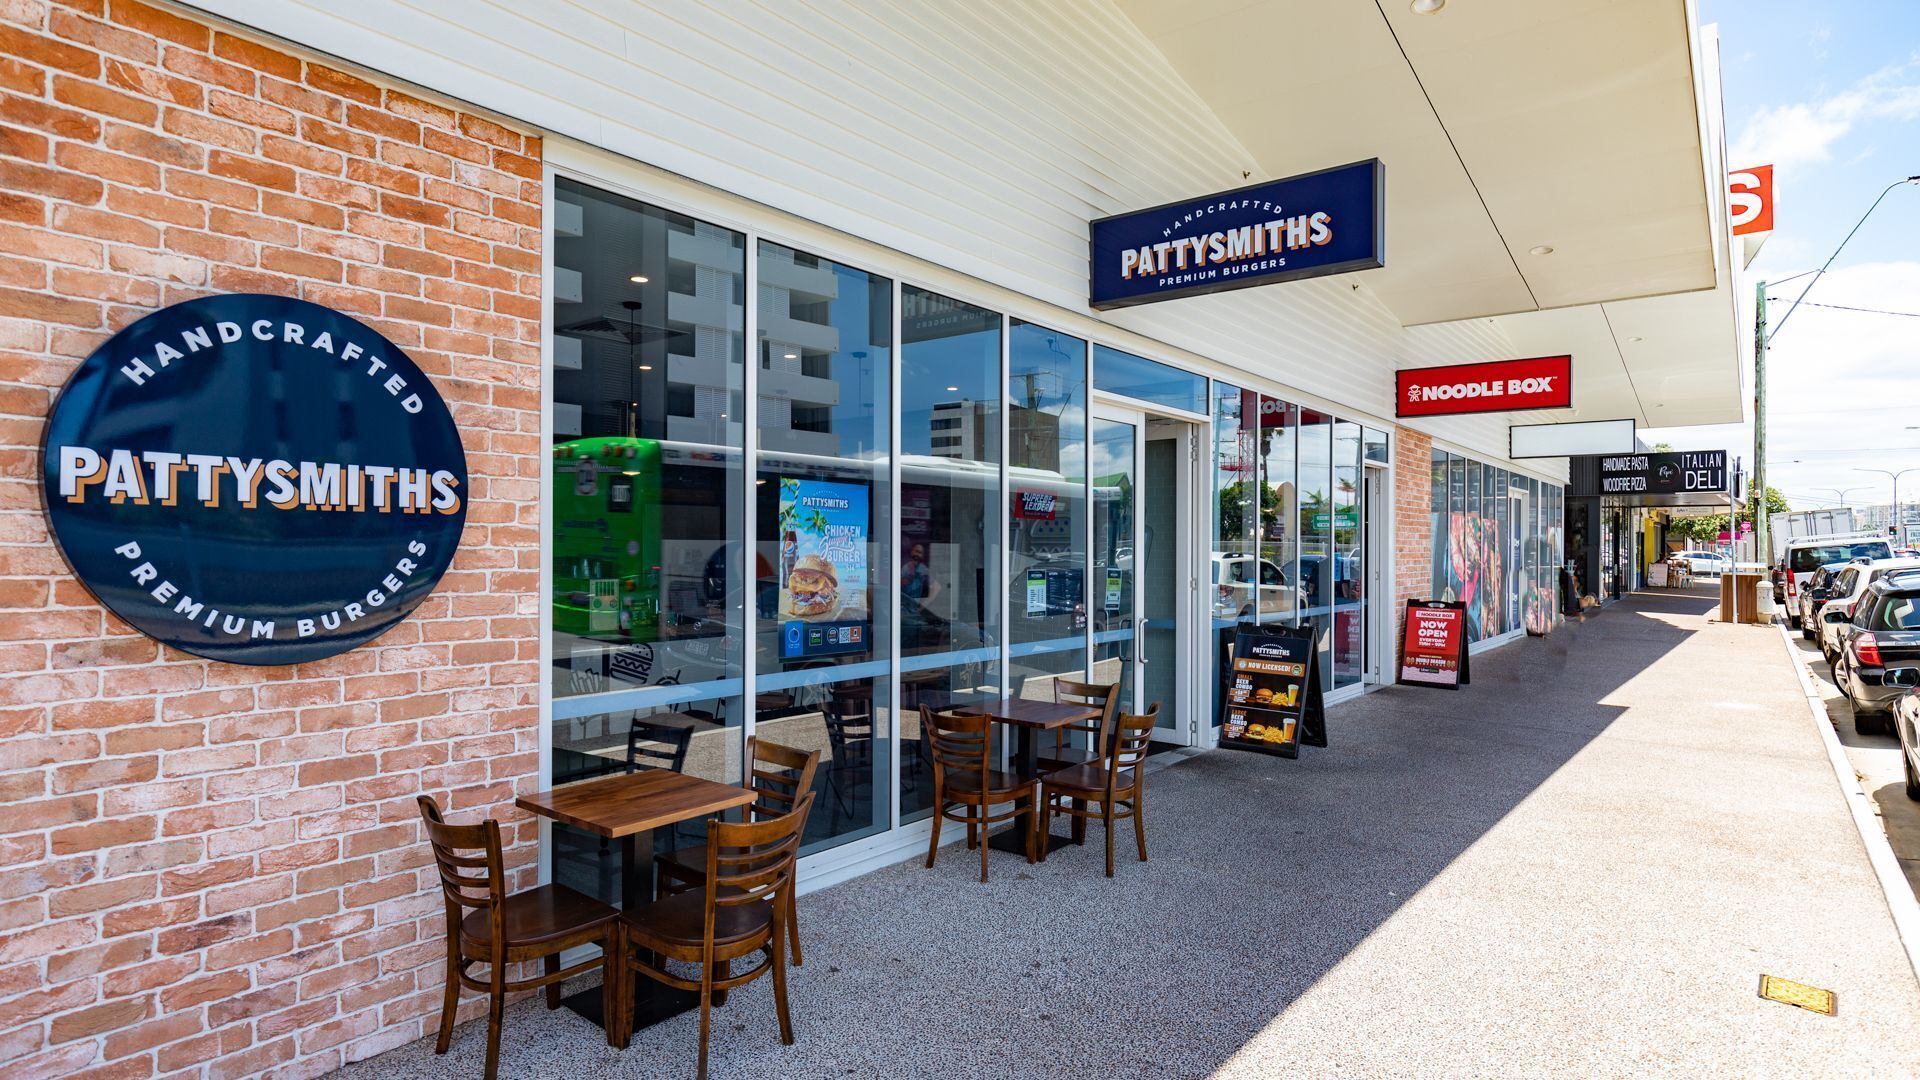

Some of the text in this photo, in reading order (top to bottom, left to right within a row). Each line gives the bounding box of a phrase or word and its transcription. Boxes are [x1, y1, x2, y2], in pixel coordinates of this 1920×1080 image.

[1162, 200, 1283, 238] HANDCRAFTED
[1121, 211, 1333, 280] PATTYSMITHS
[1159, 257, 1287, 287] PREMIUM BURGERS
[121, 318, 425, 415] HANDCRAFTED
[1422, 380, 1504, 401] NOODLE
[1602, 456, 1649, 472] HANDMADE PASTA
[1681, 453, 1722, 469] ITALIAN
[59, 445, 462, 516] PATTYSMITHS
[1603, 476, 1647, 492] WOODFIRE PIZZA
[1685, 470, 1722, 490] DELI
[802, 496, 849, 509] PATTYSMITHS
[1022, 492, 1053, 504] SUPREME
[825, 524, 861, 537] CHICKEN
[827, 549, 860, 562] BURGER
[115, 538, 427, 640] PREMIUM BURGERS
[1420, 620, 1447, 629] NOW
[1418, 629, 1448, 638] OPEN
[1252, 646, 1291, 656] PATTYSMITHS
[1262, 663, 1291, 672] LICENSED!
[1235, 683, 1253, 691] COMBO
[1230, 719, 1248, 727] COMBO
